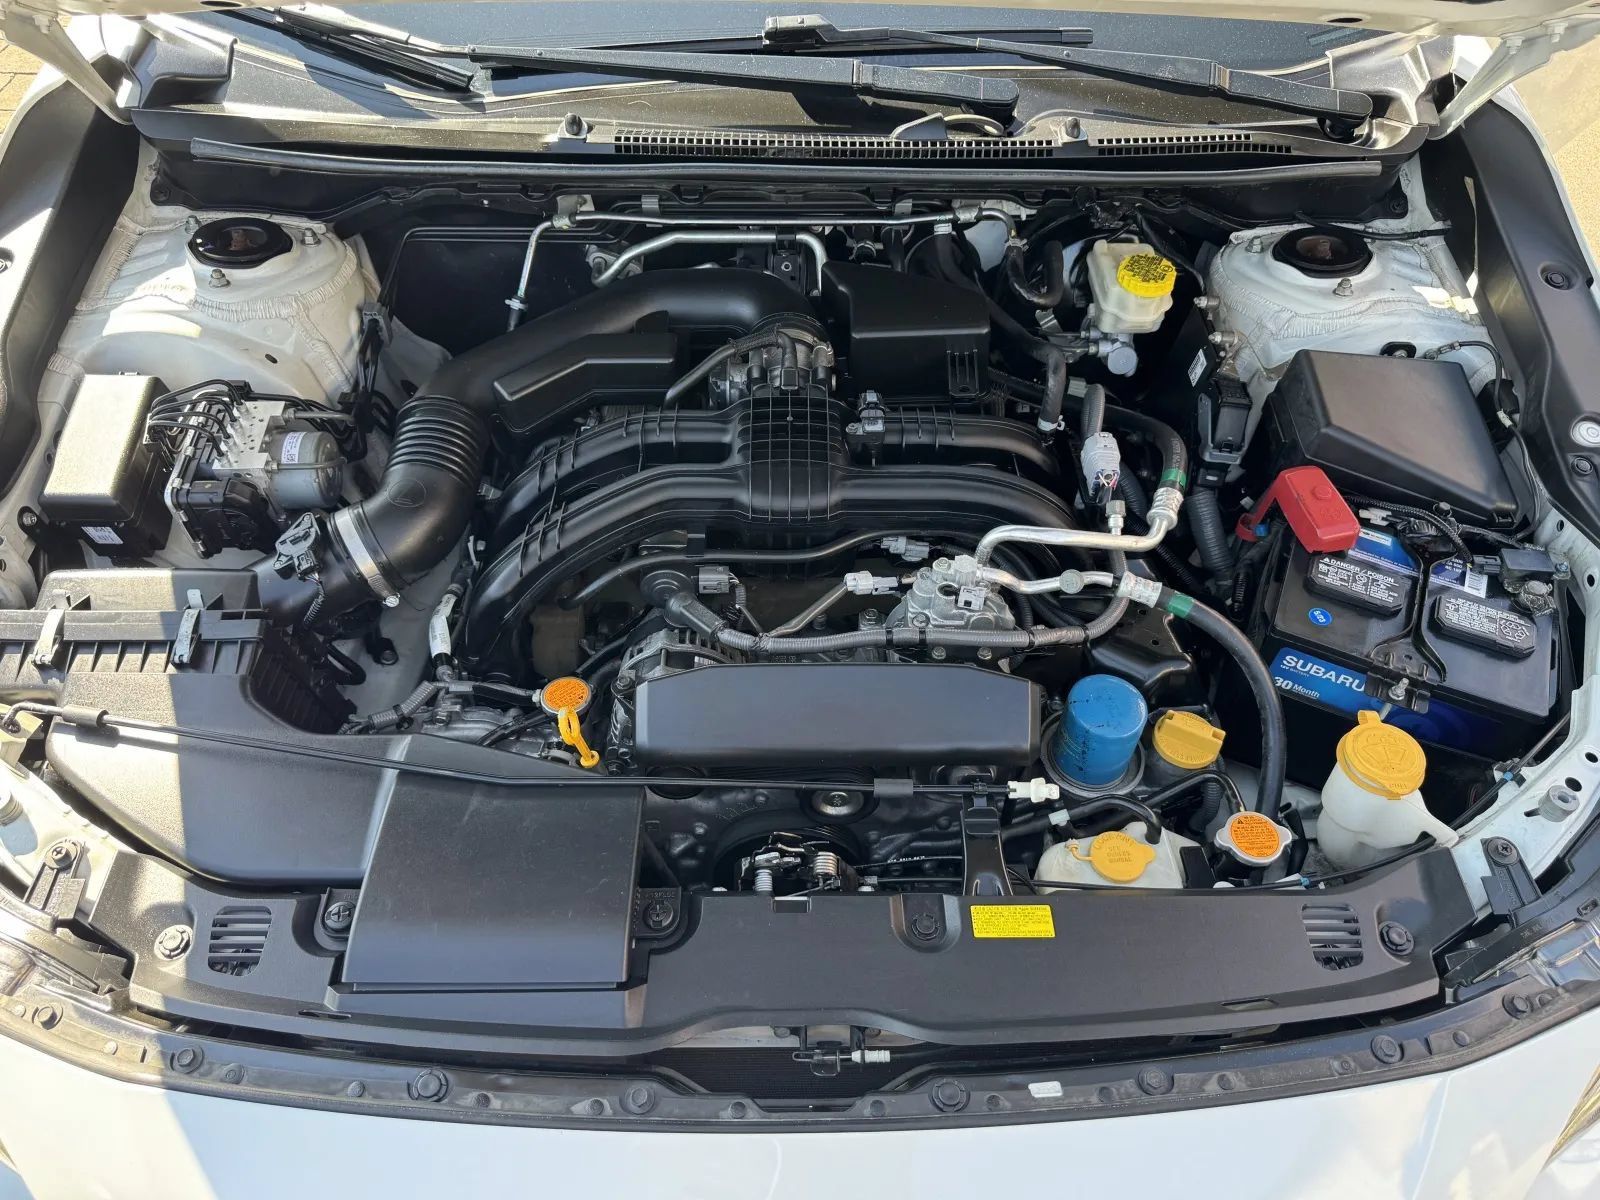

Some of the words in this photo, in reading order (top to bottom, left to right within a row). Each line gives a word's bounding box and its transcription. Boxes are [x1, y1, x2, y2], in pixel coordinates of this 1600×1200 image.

[1330, 559, 1360, 572] DANGER
[1367, 571, 1394, 583] POISON
[1282, 655, 1365, 692] SUBARU
[1274, 676, 1292, 690] 30
[1293, 683, 1320, 698] Month
